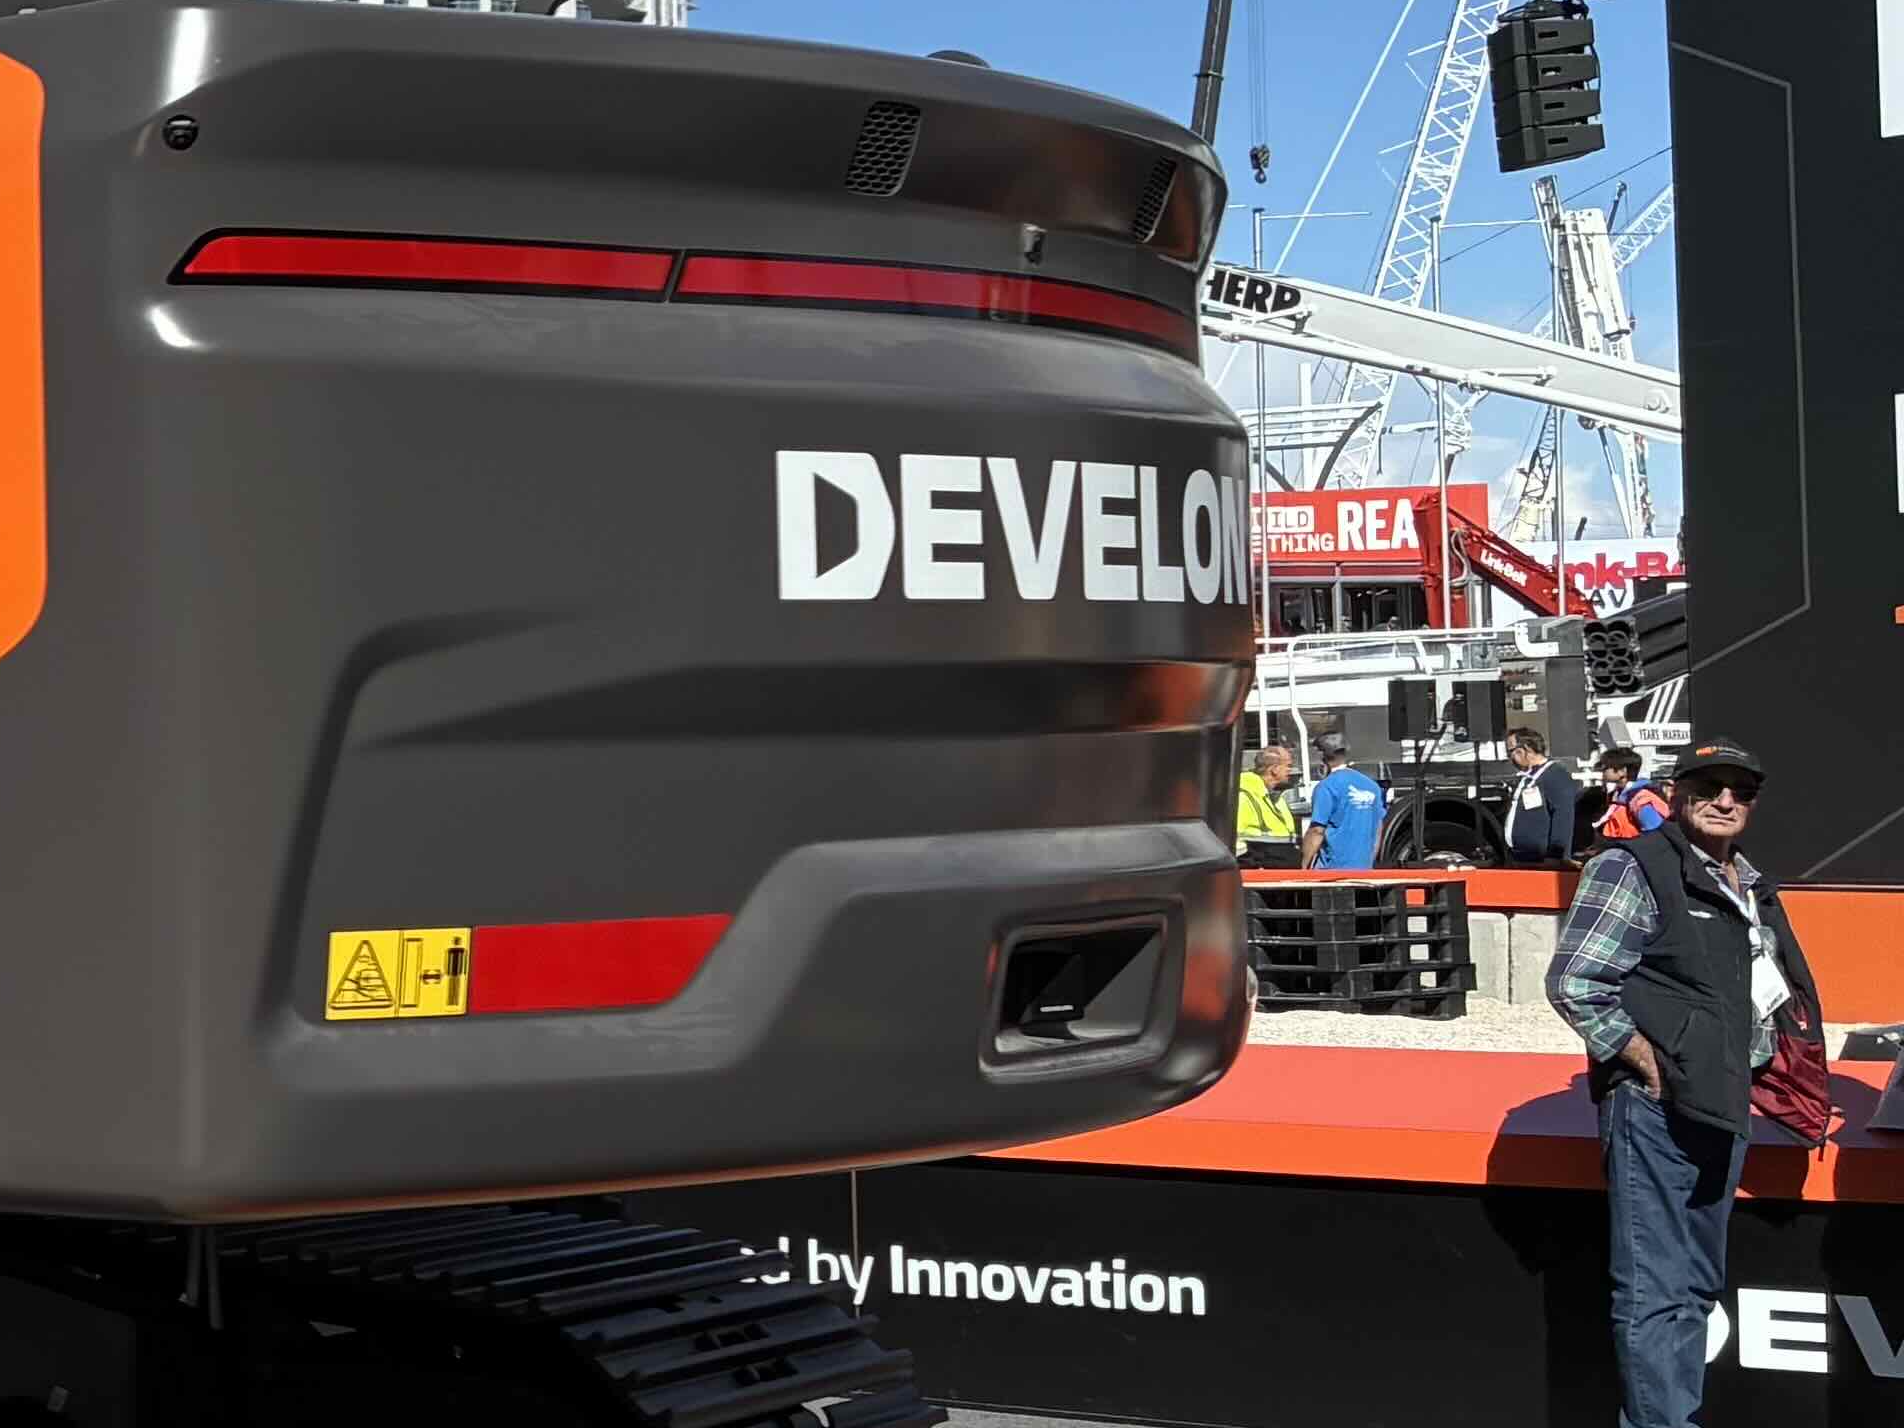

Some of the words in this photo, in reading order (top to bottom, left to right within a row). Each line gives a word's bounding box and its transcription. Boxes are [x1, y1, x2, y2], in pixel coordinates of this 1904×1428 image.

[775, 449, 1249, 605] DEVELON
[808, 1238, 874, 1307] by
[889, 1244, 1206, 1317] Innovation
[1704, 1287, 1904, 1380] EV
